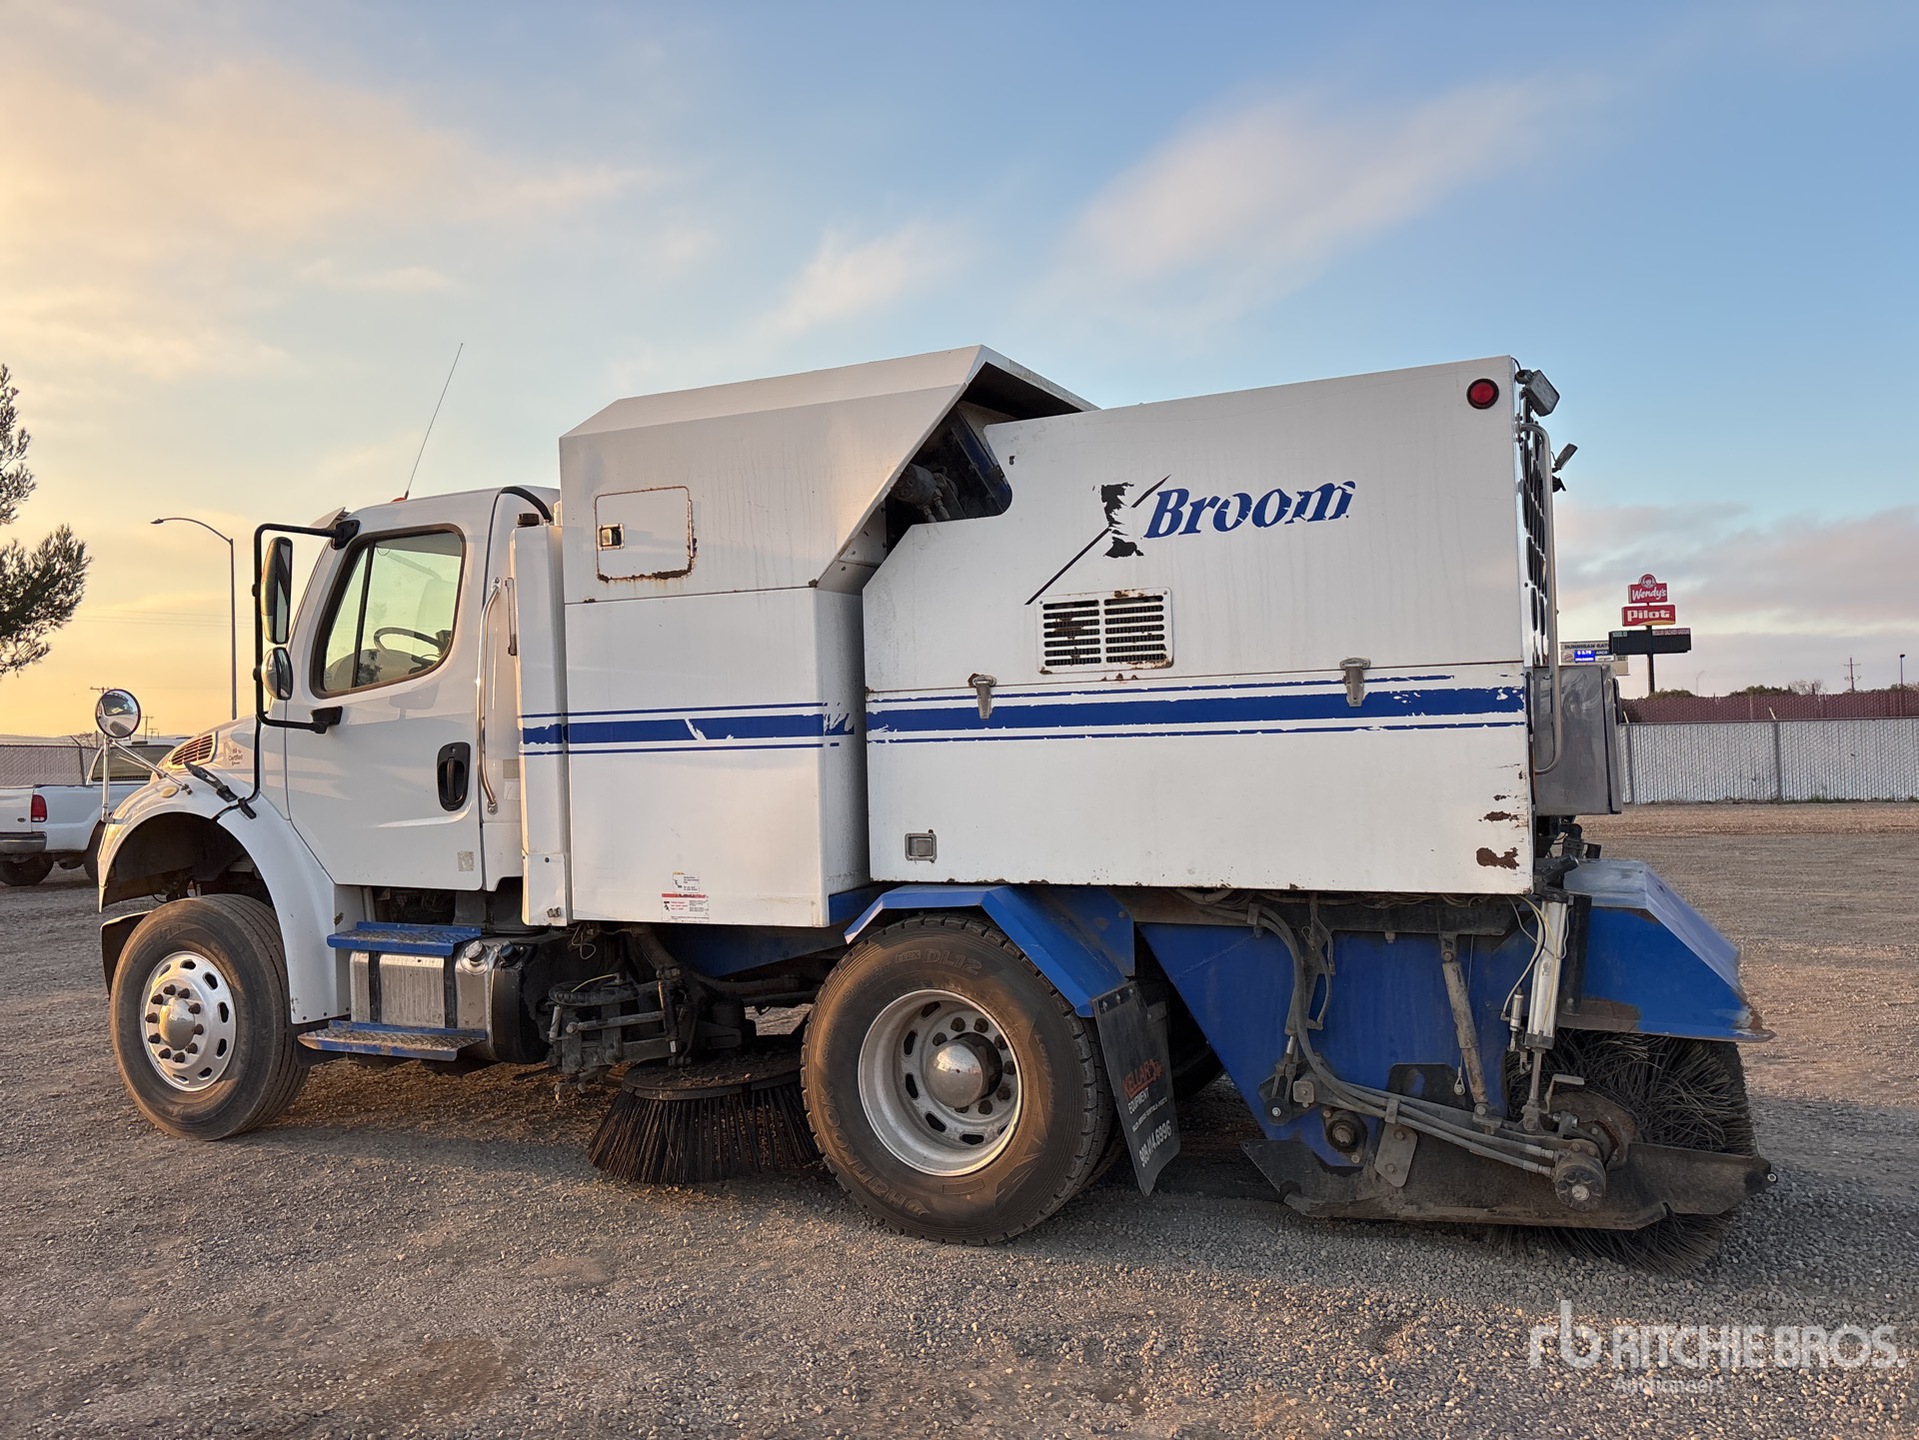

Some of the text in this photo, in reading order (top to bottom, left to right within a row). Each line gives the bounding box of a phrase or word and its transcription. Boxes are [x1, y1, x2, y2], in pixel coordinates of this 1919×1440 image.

[1143, 480, 1357, 539] Broom
[1632, 587, 1666, 601] Wendy's
[1627, 610, 1670, 622] Pilot
[924, 948, 982, 976] DL12
